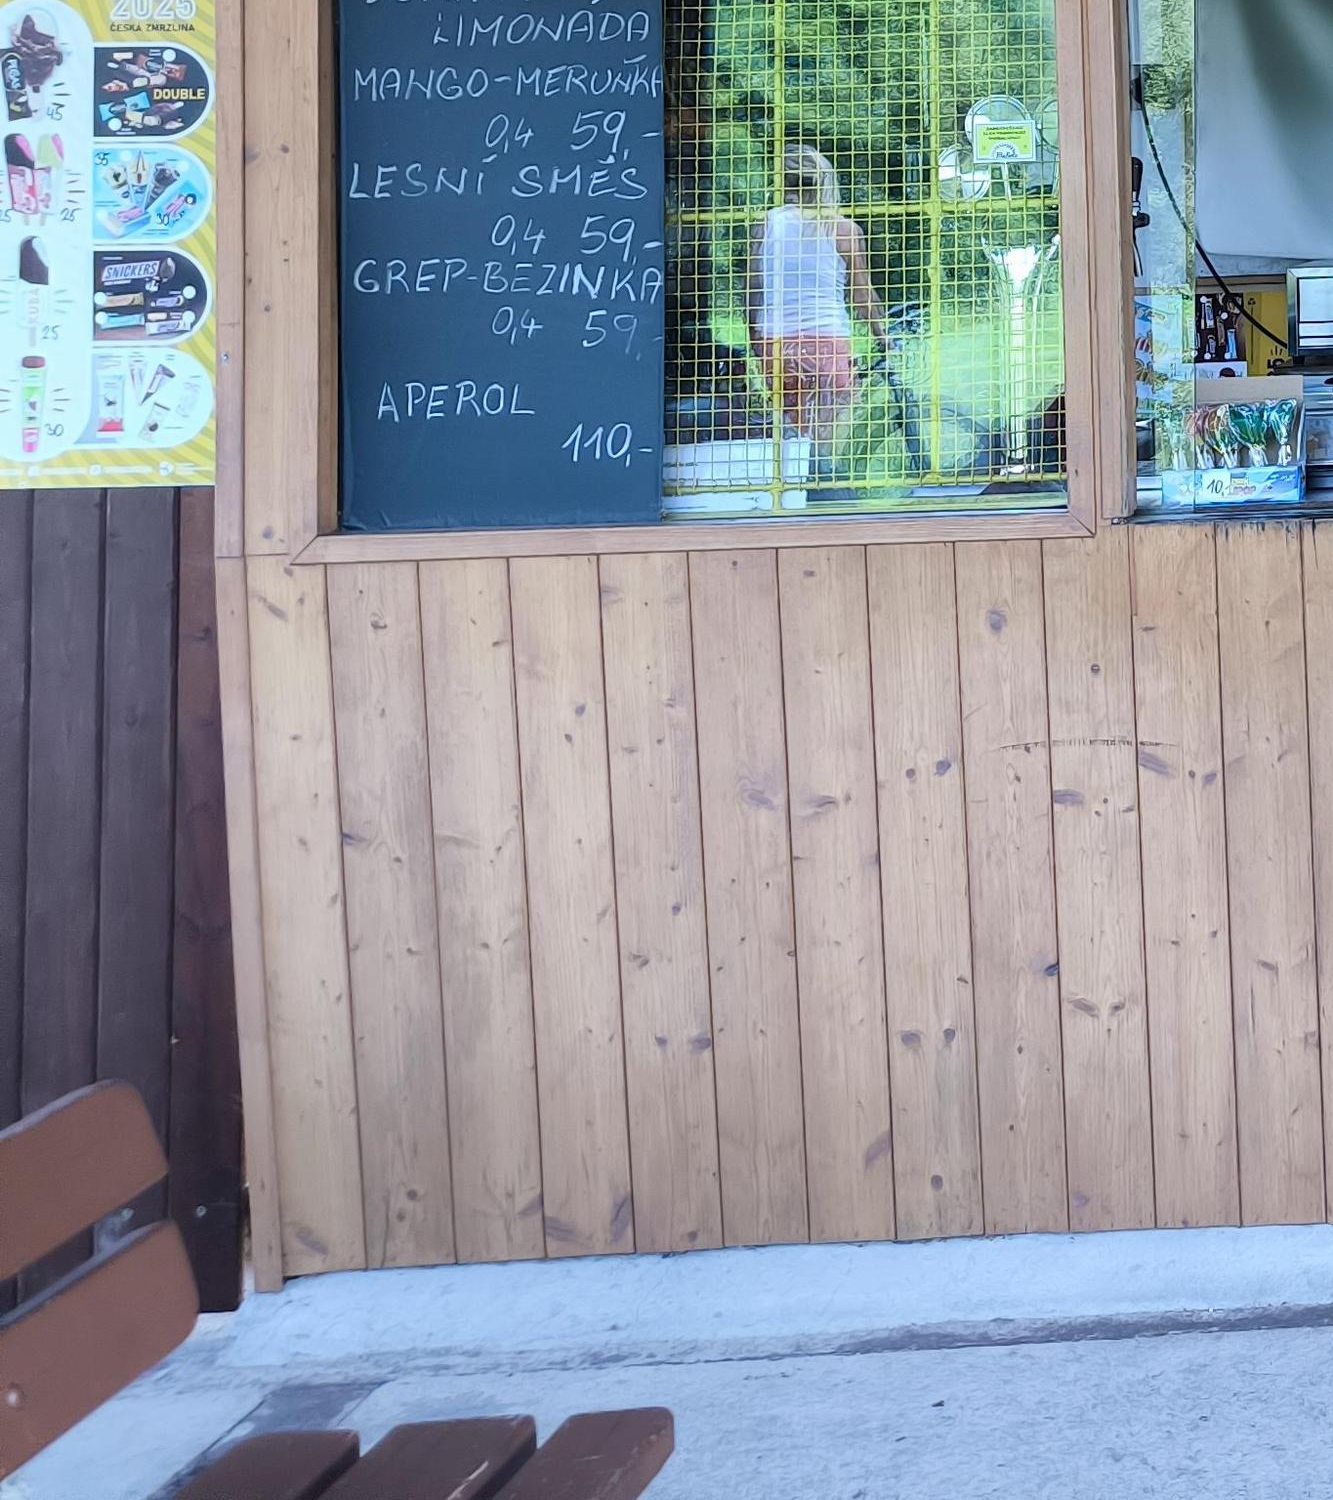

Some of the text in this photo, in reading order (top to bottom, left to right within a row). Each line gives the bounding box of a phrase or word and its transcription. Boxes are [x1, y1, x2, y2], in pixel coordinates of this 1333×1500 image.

[146, 23, 196, 32] ZMRZLINA
[152, 88, 206, 100] DOUBLE
[484, 113, 534, 154] 0,4
[349, 153, 499, 199] LESNÍ
[491, 214, 547, 256] 0,4
[104, 262, 158, 279] SNICKERS
[353, 258, 664, 305] GREP-BEZINKA
[491, 306, 544, 346] 0,4
[377, 380, 537, 423] APEROL
